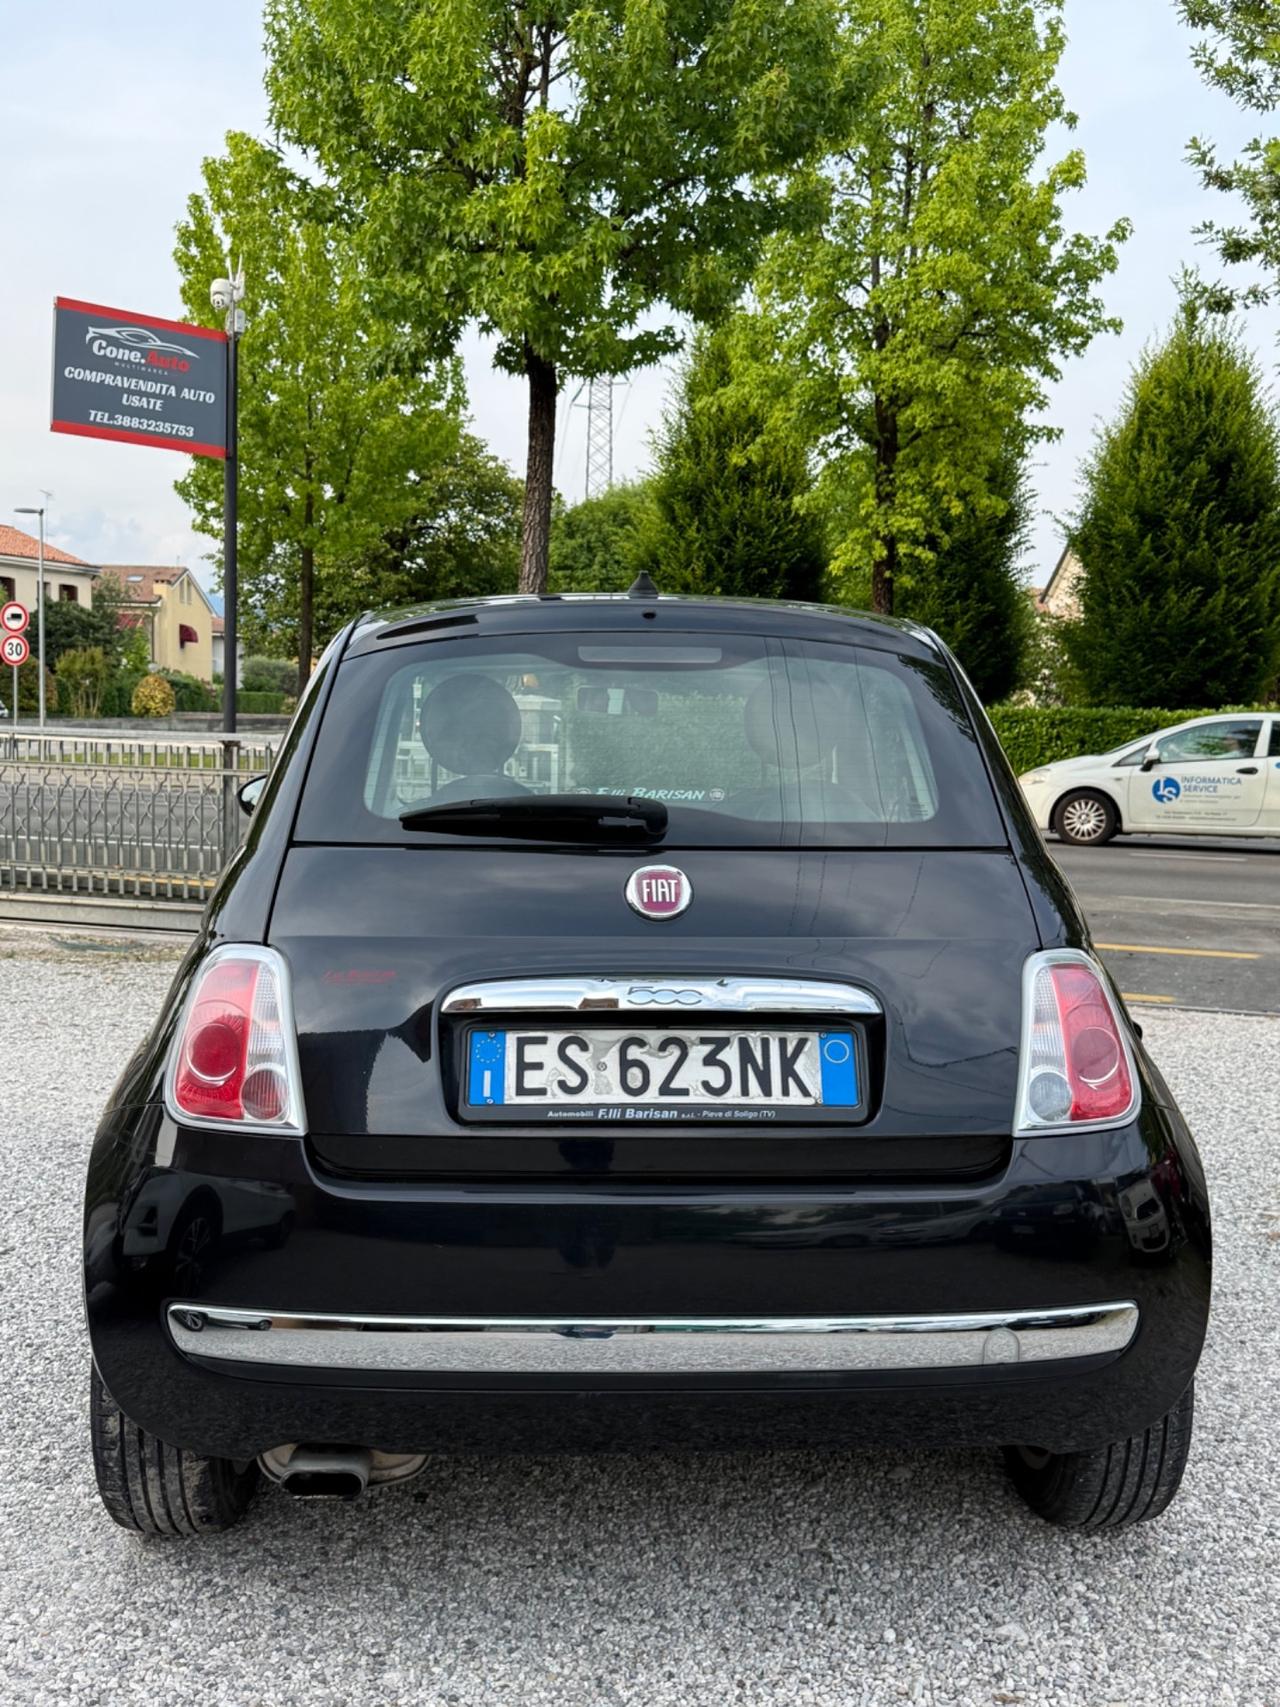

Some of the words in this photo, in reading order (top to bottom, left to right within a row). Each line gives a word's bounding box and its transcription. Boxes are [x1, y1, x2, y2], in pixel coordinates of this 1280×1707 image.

[64, 366, 177, 397] COMPRAVENDITA
[180, 388, 216, 404] AUTO
[121, 393, 165, 412] USATE
[88, 409, 195, 438] TEL.3883235753
[7, 642, 23, 656] 30
[1181, 776, 1242, 785] INFORMATICA
[1183, 785, 1218, 793] SERVICE
[631, 787, 706, 800] BARISAN
[642, 879, 679, 903] FIAT
[626, 986, 703, 1006] 500
[515, 1036, 590, 1097] ES
[618, 1036, 813, 1098] 623NK
[598, 1108, 622, 1119] F.lli
[625, 1108, 678, 1119] Barisan
[702, 1110, 723, 1118] Pieve
[724, 1110, 732, 1118] di
[734, 1110, 758, 1119] Soligo
[759, 1110, 776, 1118] (TV)
